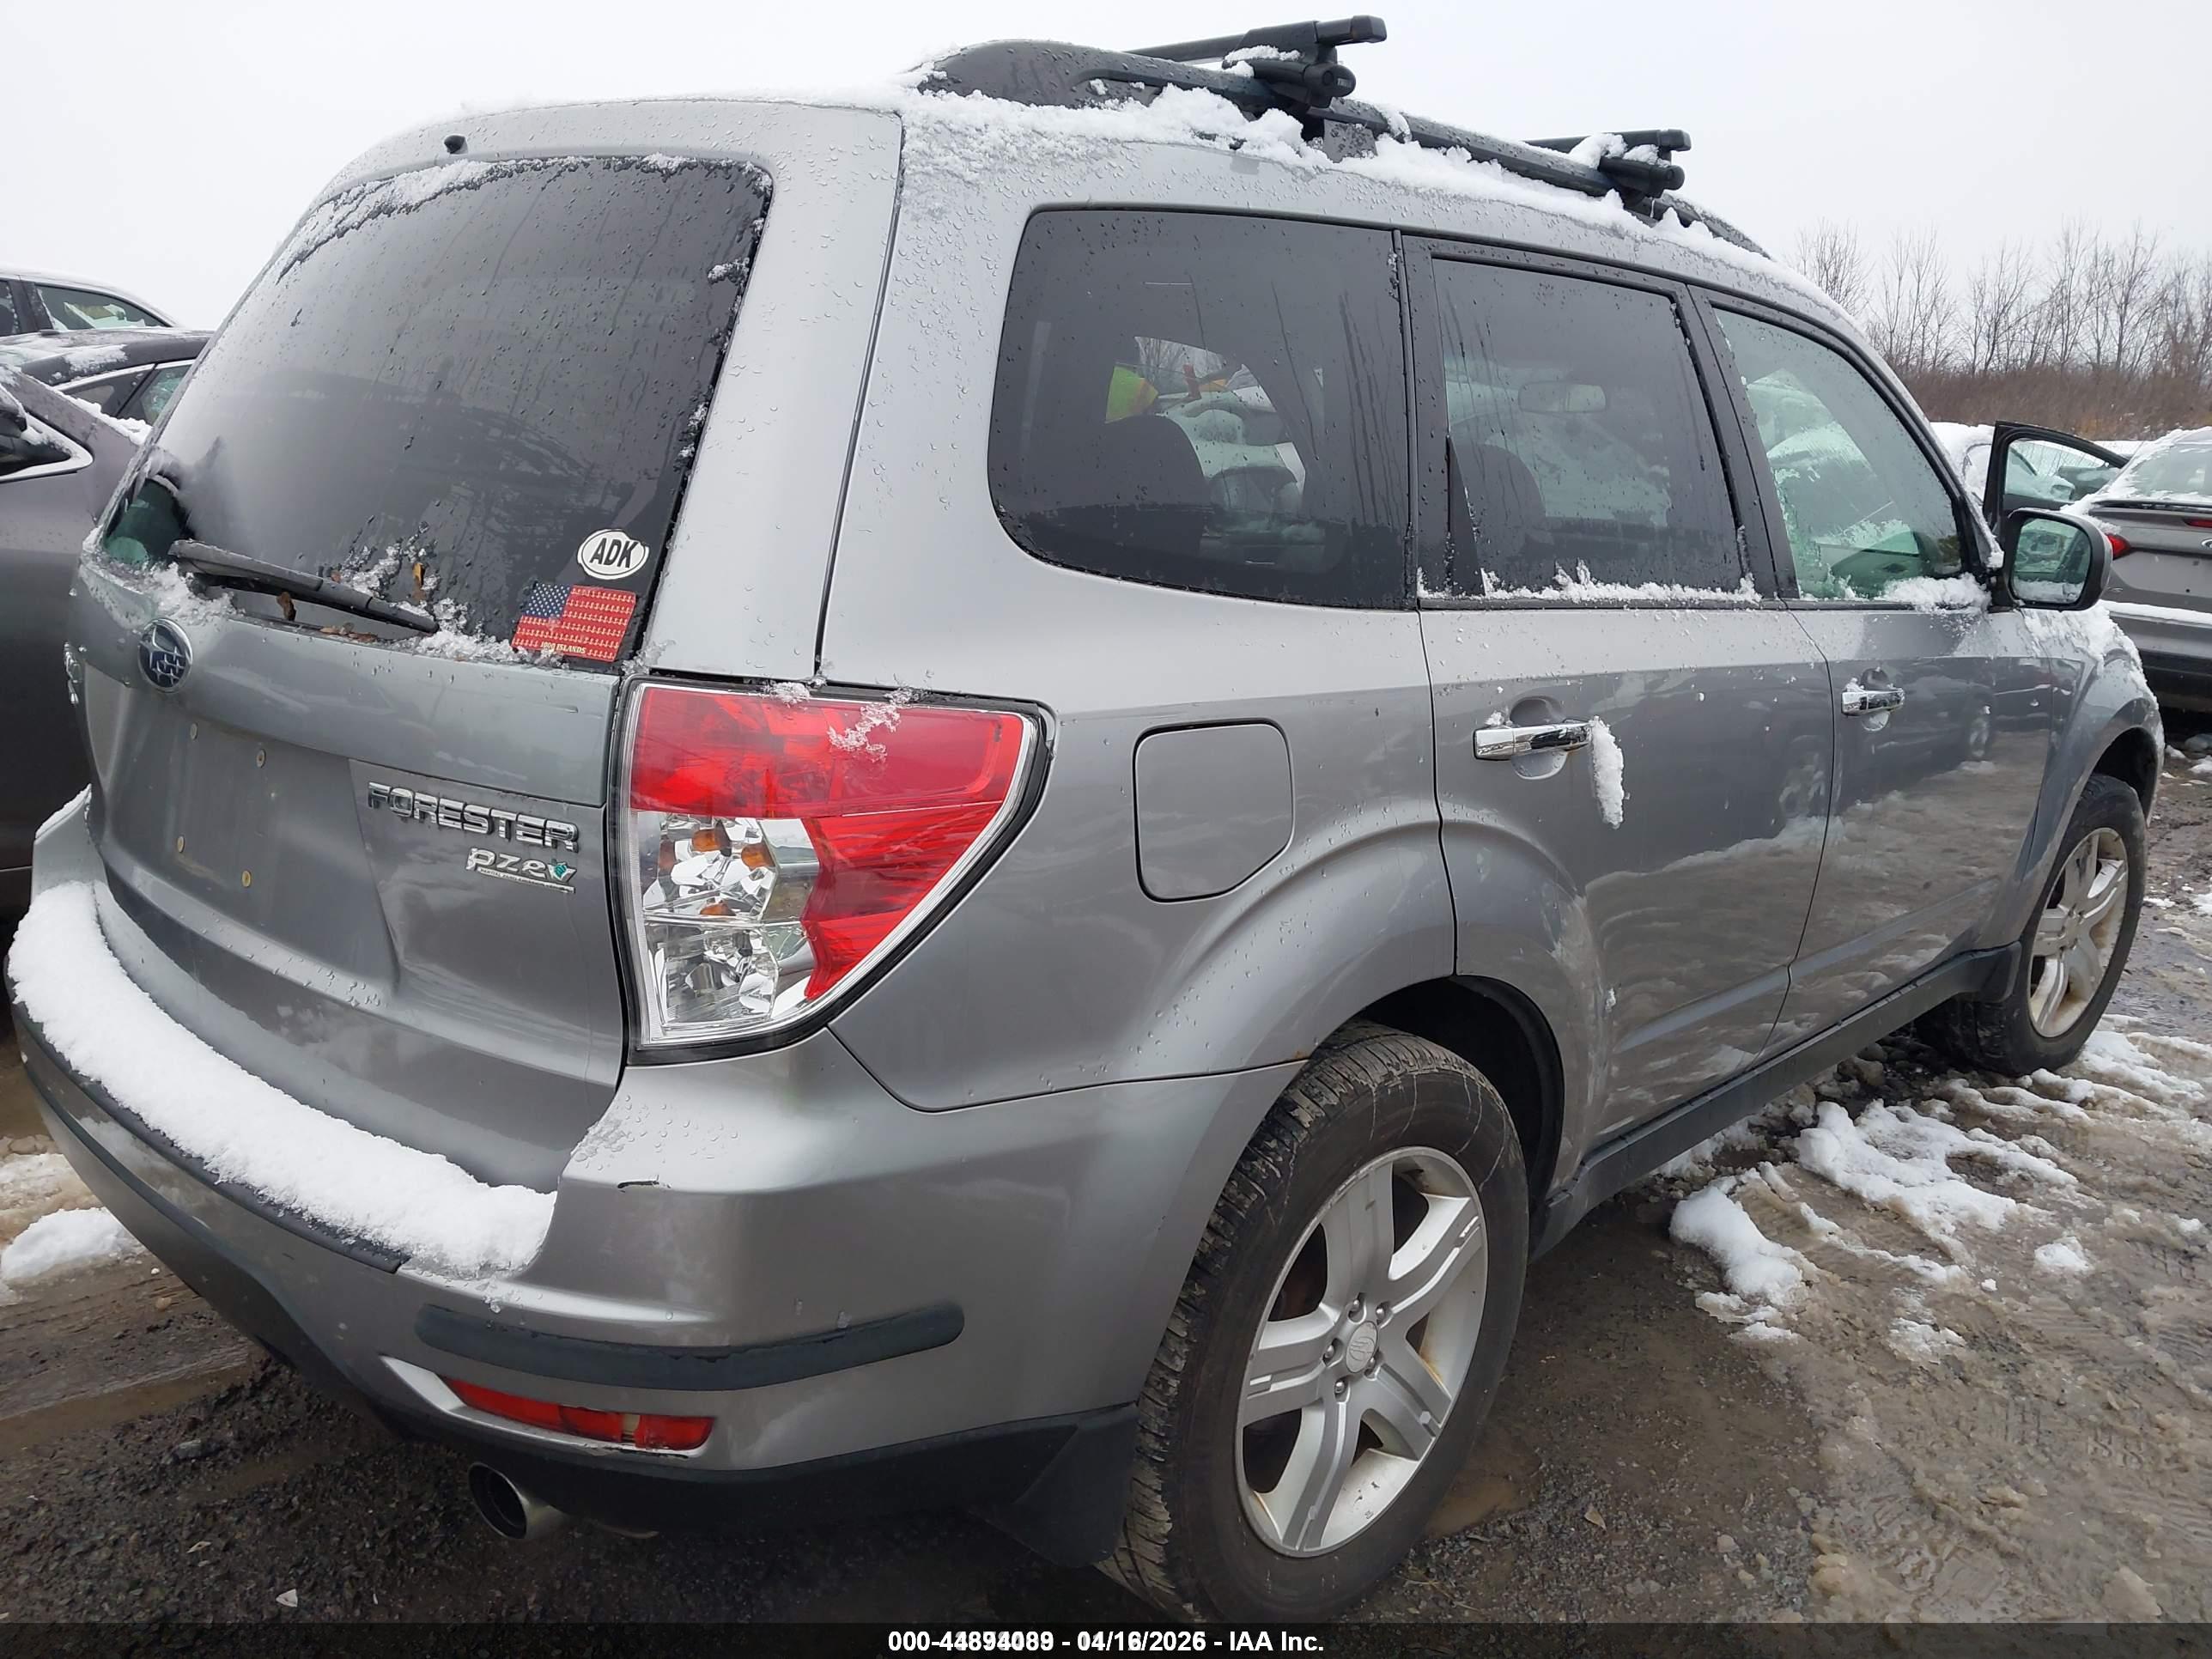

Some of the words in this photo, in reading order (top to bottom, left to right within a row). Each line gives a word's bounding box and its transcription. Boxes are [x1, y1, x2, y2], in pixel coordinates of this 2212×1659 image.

[589, 538, 638, 568] ADK
[556, 643, 586, 653] ISLANDS
[368, 781, 579, 853] FORESTER
